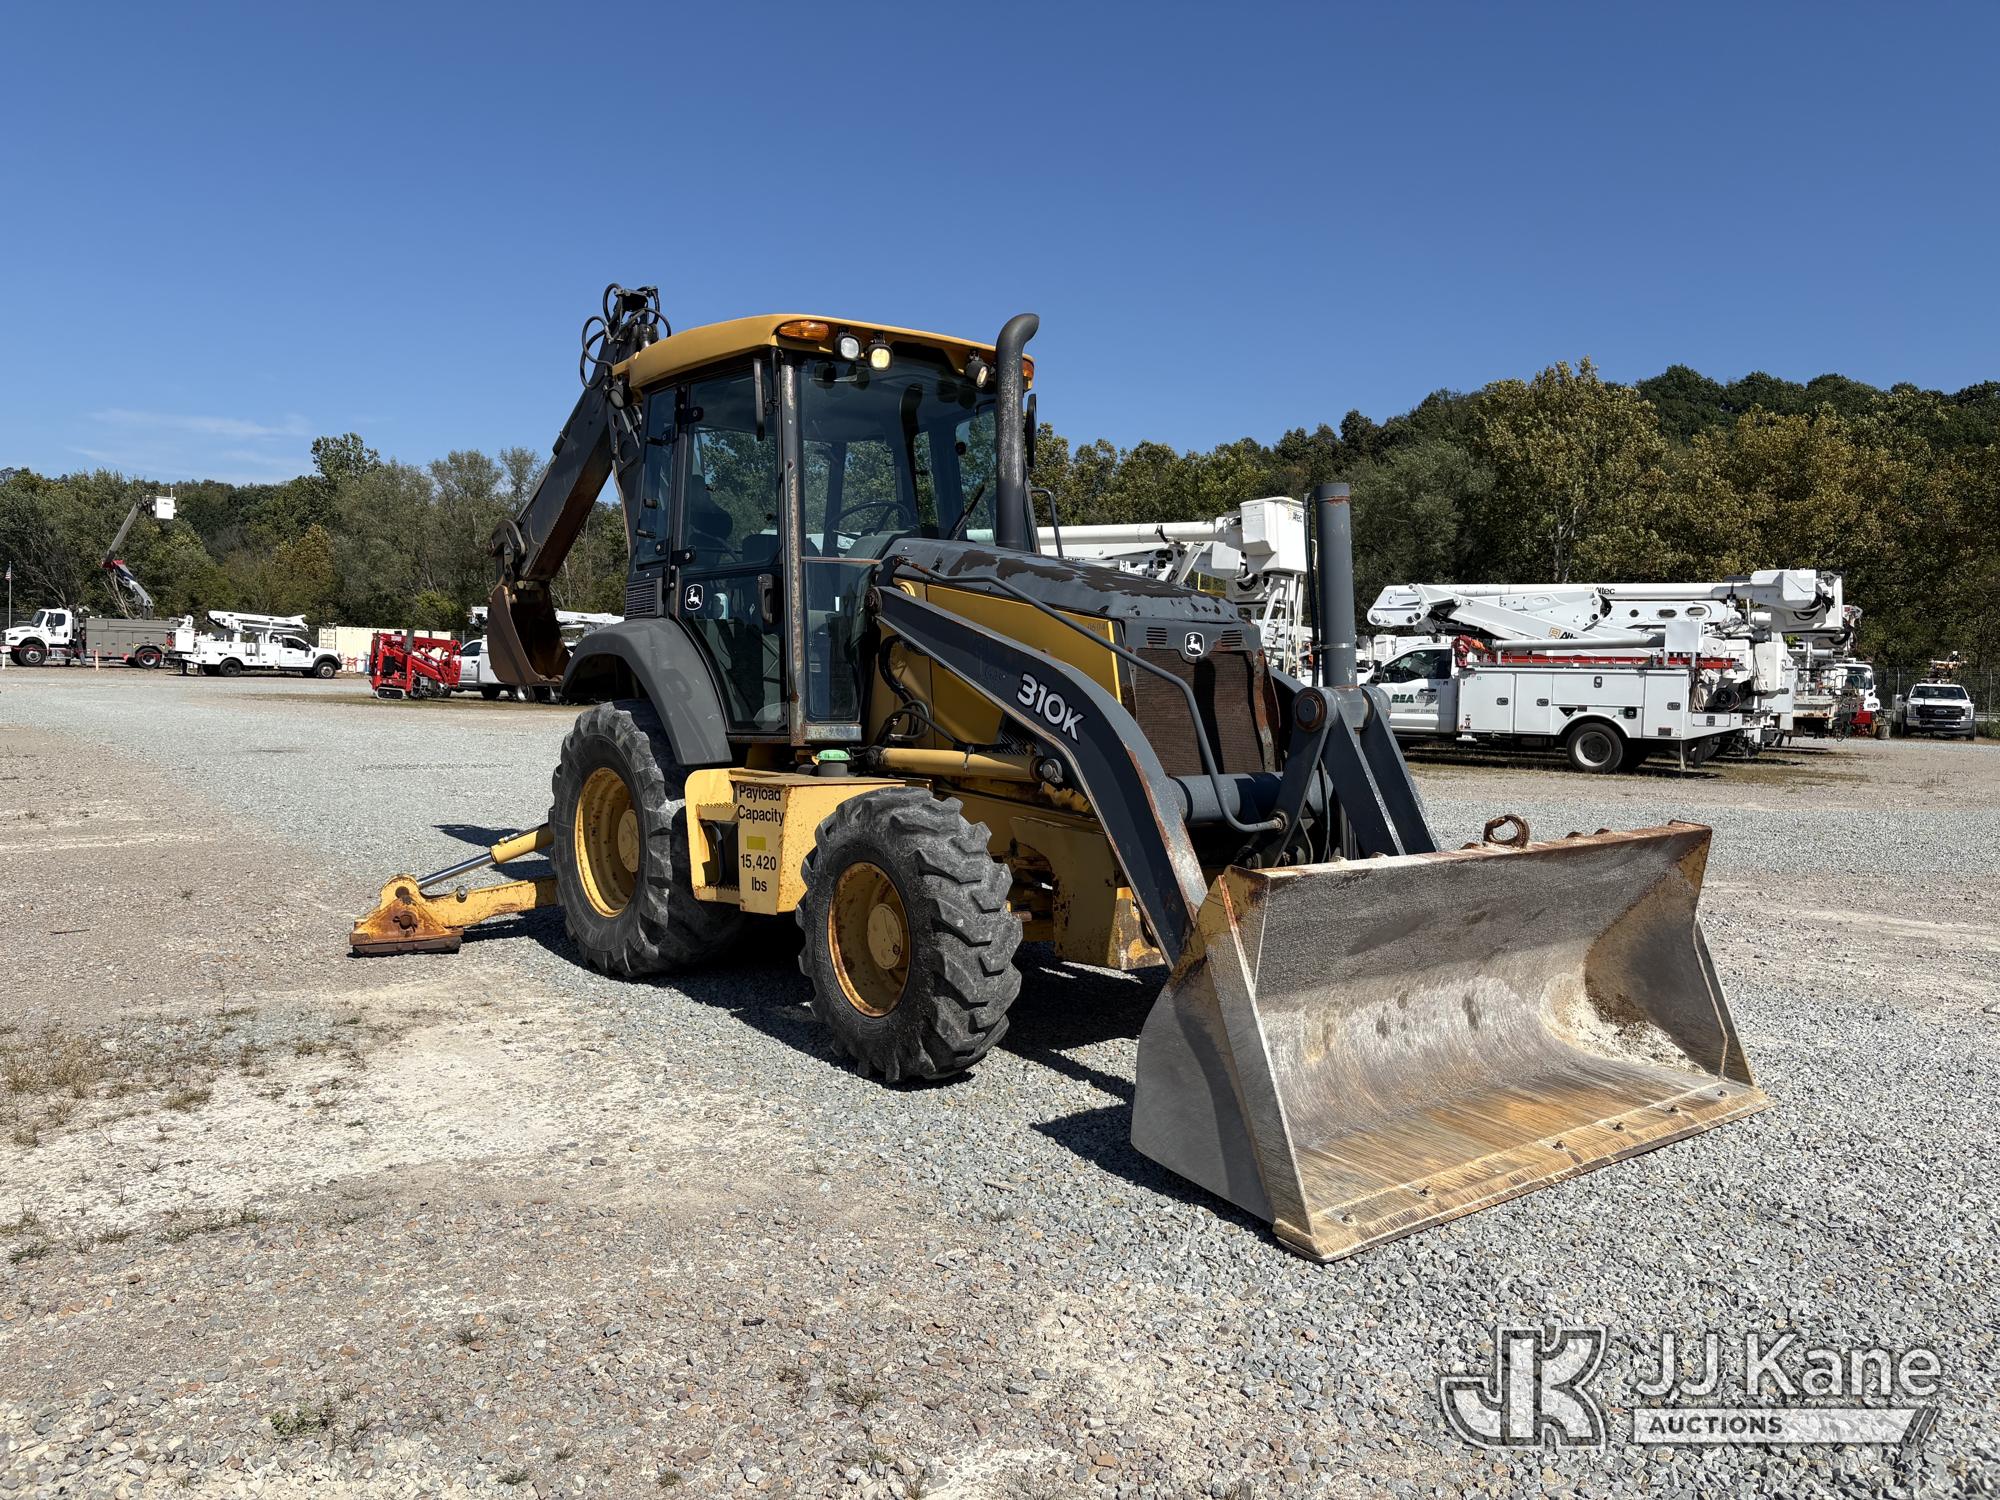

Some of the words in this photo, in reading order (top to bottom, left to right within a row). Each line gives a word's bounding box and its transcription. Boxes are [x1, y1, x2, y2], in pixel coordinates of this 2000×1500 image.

[1017, 673, 1084, 741] 310K
[1391, 694, 1415, 704] REA
[739, 784, 781, 802] Payload
[737, 804, 785, 827] Capacity
[740, 854, 777, 871] 15,420
[751, 877, 768, 892] lbs
